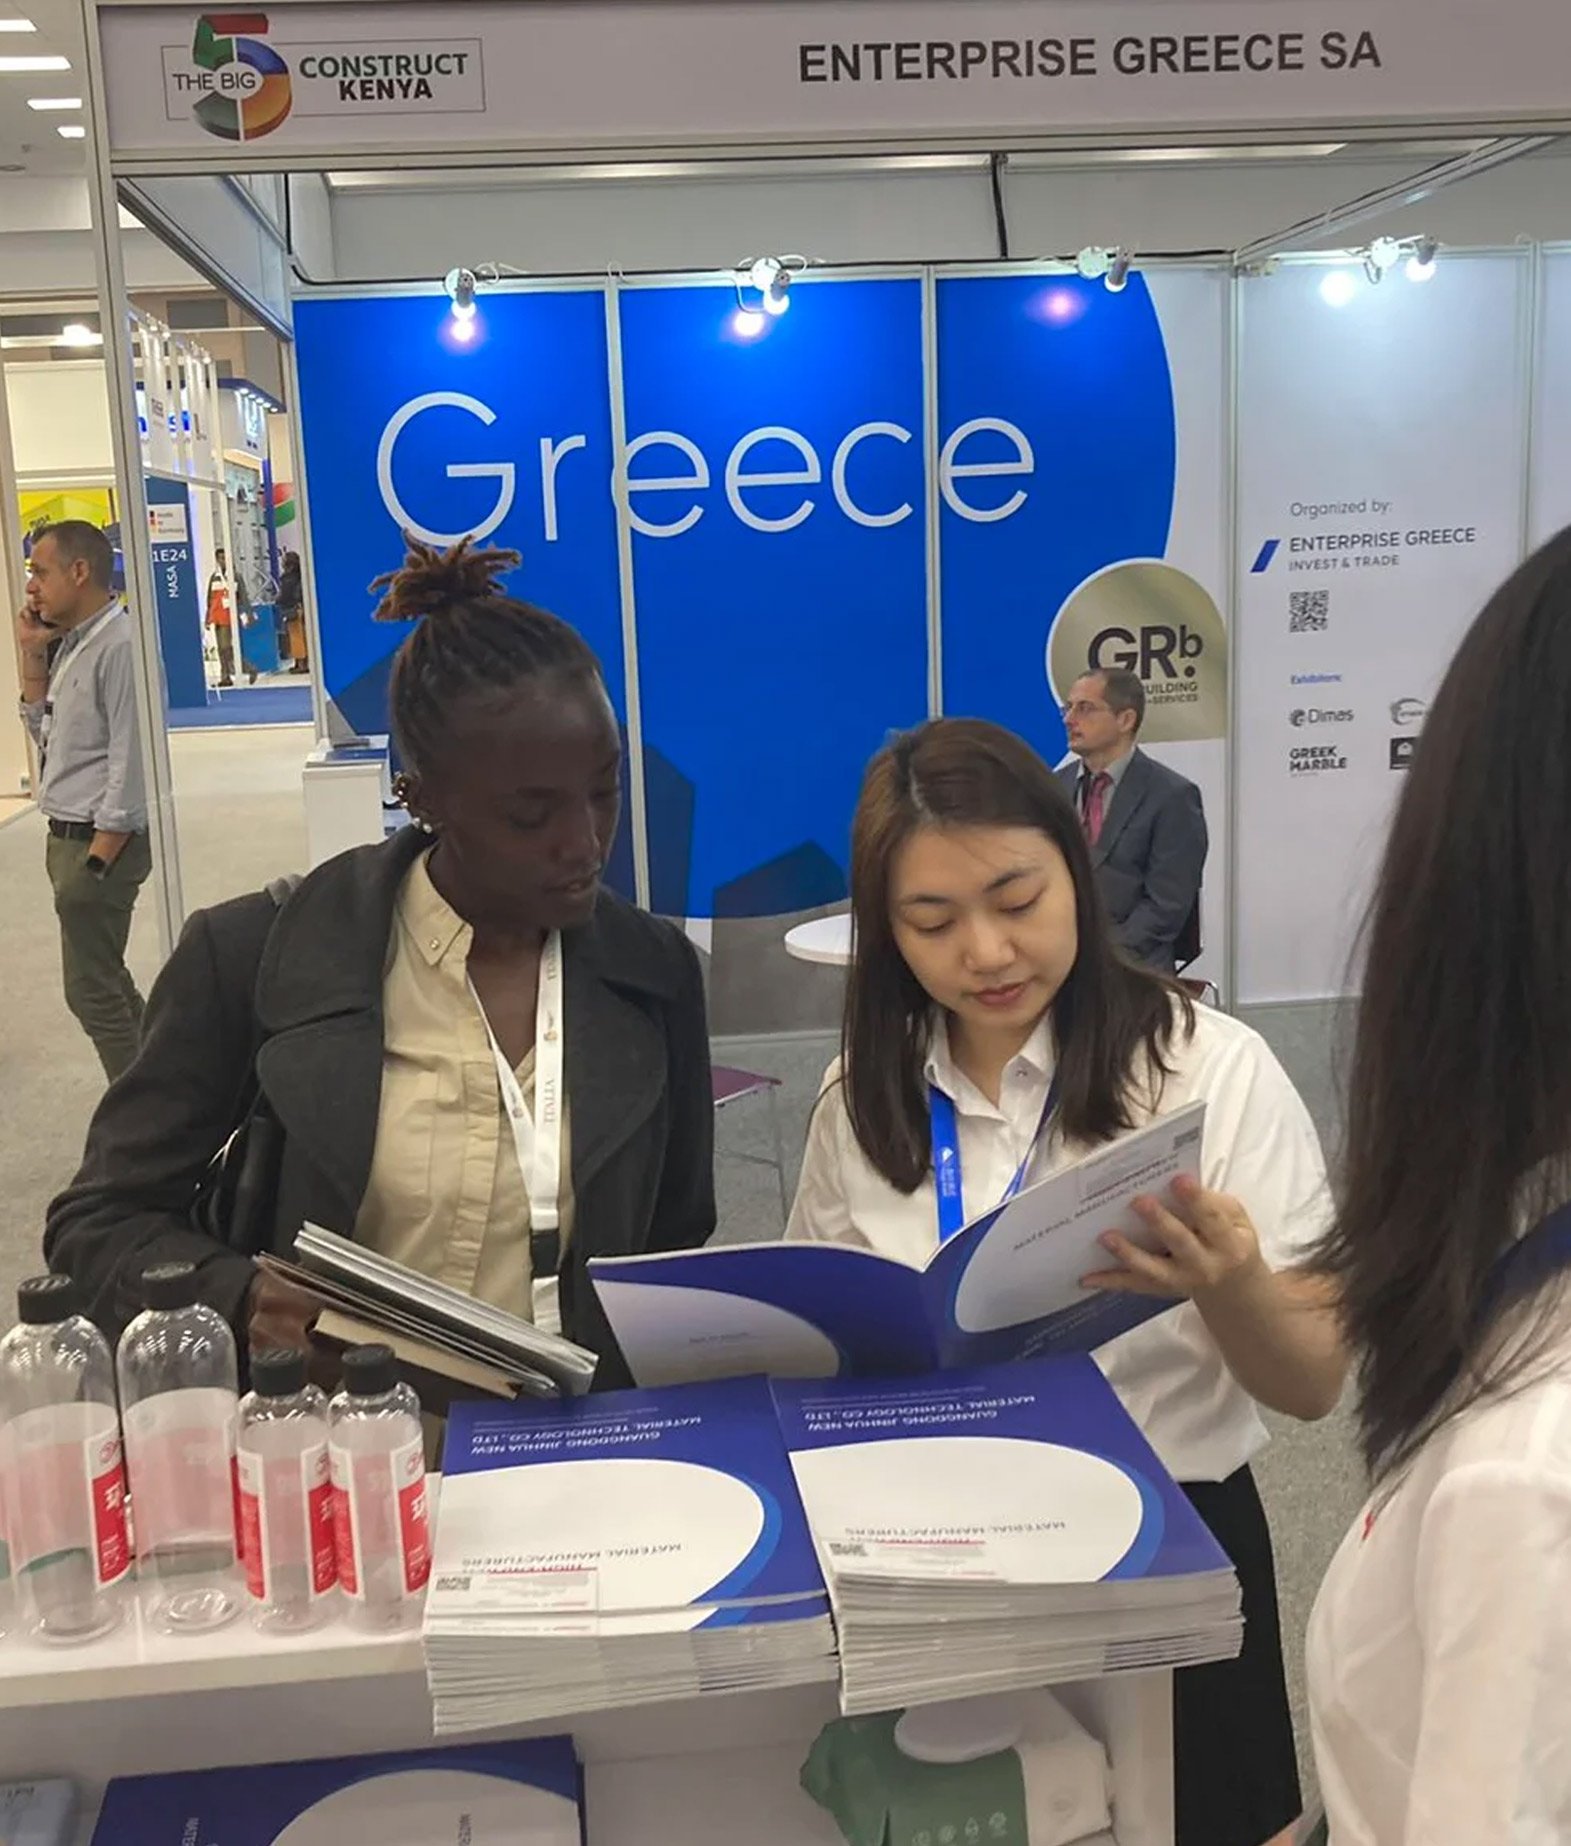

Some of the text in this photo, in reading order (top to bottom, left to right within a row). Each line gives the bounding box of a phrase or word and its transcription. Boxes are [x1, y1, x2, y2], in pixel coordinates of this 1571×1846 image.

[299, 53, 468, 79] CONSTRUCT
[799, 31, 1383, 83] ENTERPRISE GREECE SA
[172, 73, 214, 91] THE
[220, 71, 256, 90] BIG
[339, 77, 433, 102] KENYA
[377, 390, 1035, 548] Greece
[1290, 498, 1393, 520] Organized by:
[1289, 527, 1477, 553] ENTERPRISE GREECE
[153, 549, 187, 562] 1E24
[1288, 557, 1338, 572] INVEST
[1354, 554, 1400, 568] TRADE
[1145, 681, 1199, 695] UILDING
[1307, 708, 1355, 724] Dimas
[1289, 746, 1338, 760] GREEK
[1289, 757, 1348, 772] MARBLE
[864, 1402, 962, 1420] TECHNOLOGY
[967, 1395, 1036, 1411] MATERIAL
[636, 1416, 702, 1433] MATERIAL
[807, 1421, 843, 1432] NEW
[471, 1431, 661, 1455] GUANGDONG JINHUA NEW
[532, 1425, 630, 1443] TECHNOLOGY
[461, 1542, 682, 1567] MATERIAL MANUFACTURERS
